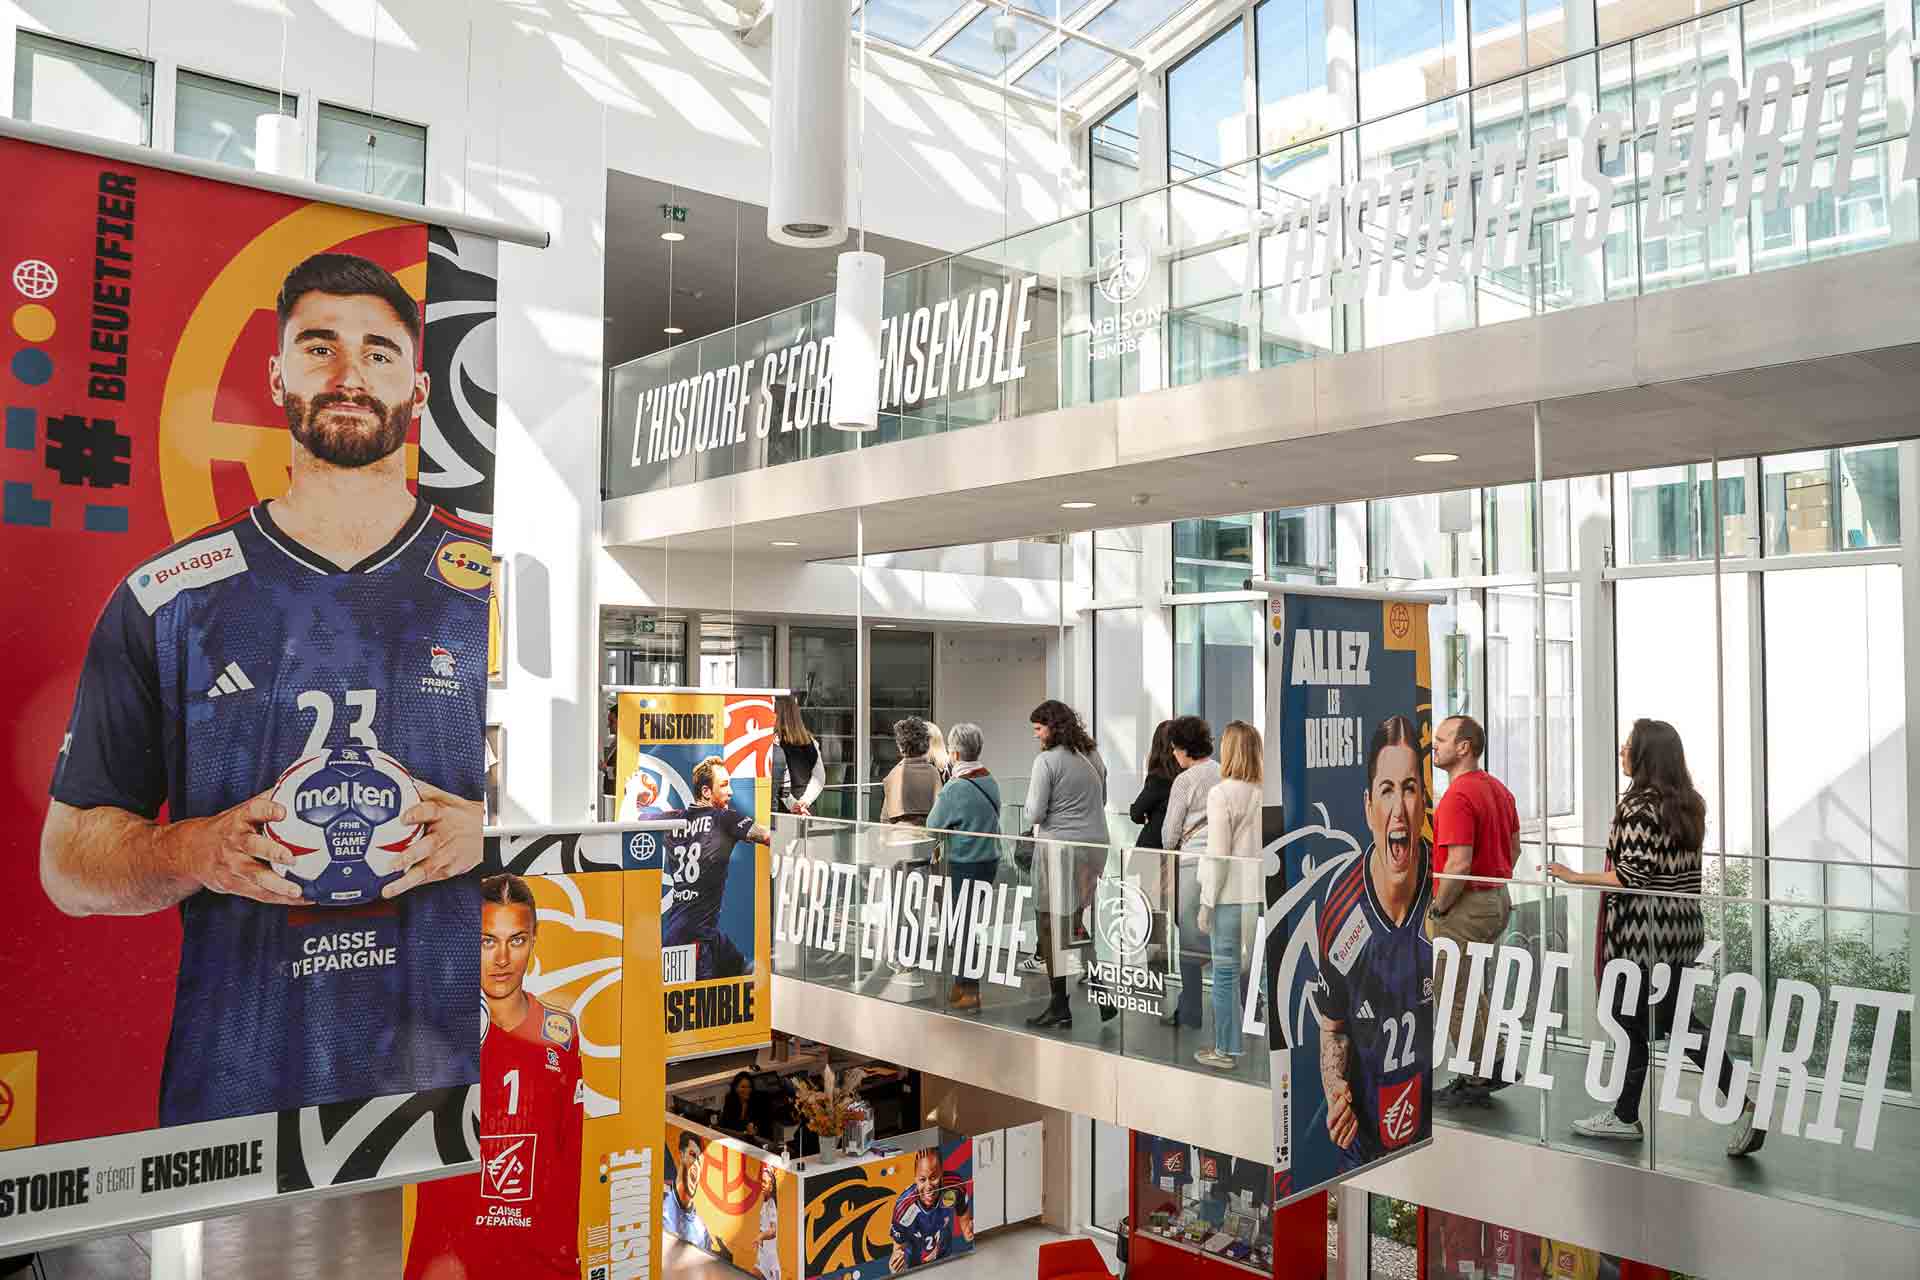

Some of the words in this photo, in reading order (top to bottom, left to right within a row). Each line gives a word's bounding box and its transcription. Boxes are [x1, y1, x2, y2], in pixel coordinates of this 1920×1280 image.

[632, 359, 755, 467] L'HISTOIRE
[756, 328, 838, 439] S'ÉCR
[155, 547, 235, 585] Butagaz
[1291, 629, 1371, 685] ALLEZ
[297, 689, 379, 761] 23
[639, 712, 715, 740] L'HISTOIRE
[297, 781, 395, 813] molten
[332, 837, 367, 847] GAME
[335, 846, 364, 857] BALL
[673, 842, 701, 884] 28
[771, 839, 857, 954] 'ÉCRIT
[861, 867, 1033, 988] ENSEMBLE
[303, 930, 377, 955] CAISSE
[292, 947, 397, 979] D'EPARGNE
[663, 949, 689, 983] CRIT
[664, 981, 755, 1035] SEMBLE
[1116, 985, 1133, 995] DU
[1382, 1010, 1417, 1073] 22
[1585, 941, 1915, 1152] S'ÉCRIT
[503, 1069, 520, 1115] 1
[0, 1166, 90, 1218] STOIRE
[96, 1166, 136, 1195] S'ÉCRIT
[141, 1139, 263, 1194] ENSEMBLE
[475, 1215, 533, 1228] D'EPARGNE
[488, 1205, 523, 1218] CAISSE
[1498, 1229, 1510, 1242] 16
